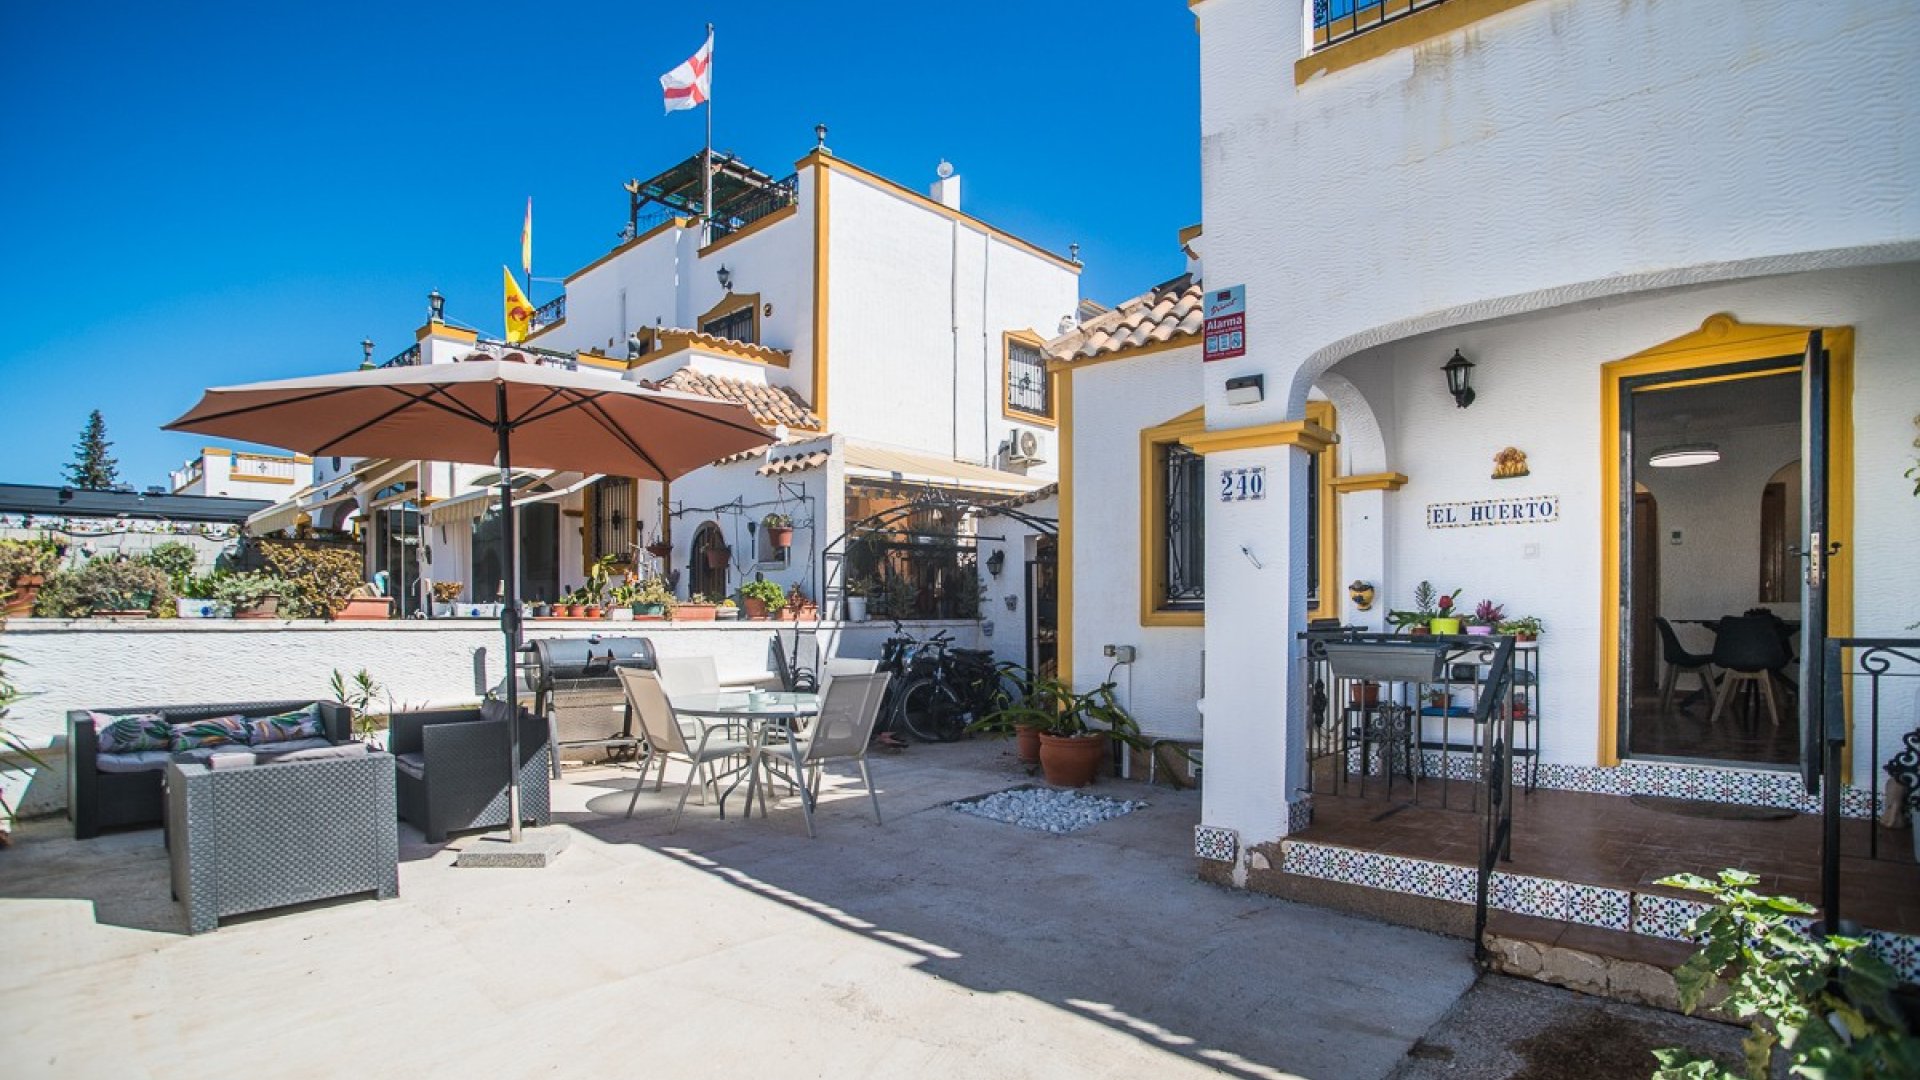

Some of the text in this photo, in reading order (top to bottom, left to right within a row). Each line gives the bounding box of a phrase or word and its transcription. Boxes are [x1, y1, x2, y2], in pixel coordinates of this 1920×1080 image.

[1207, 316, 1242, 330] Alarma
[1221, 474, 1262, 496] 240
[1433, 501, 1553, 523] EL HUERTO
